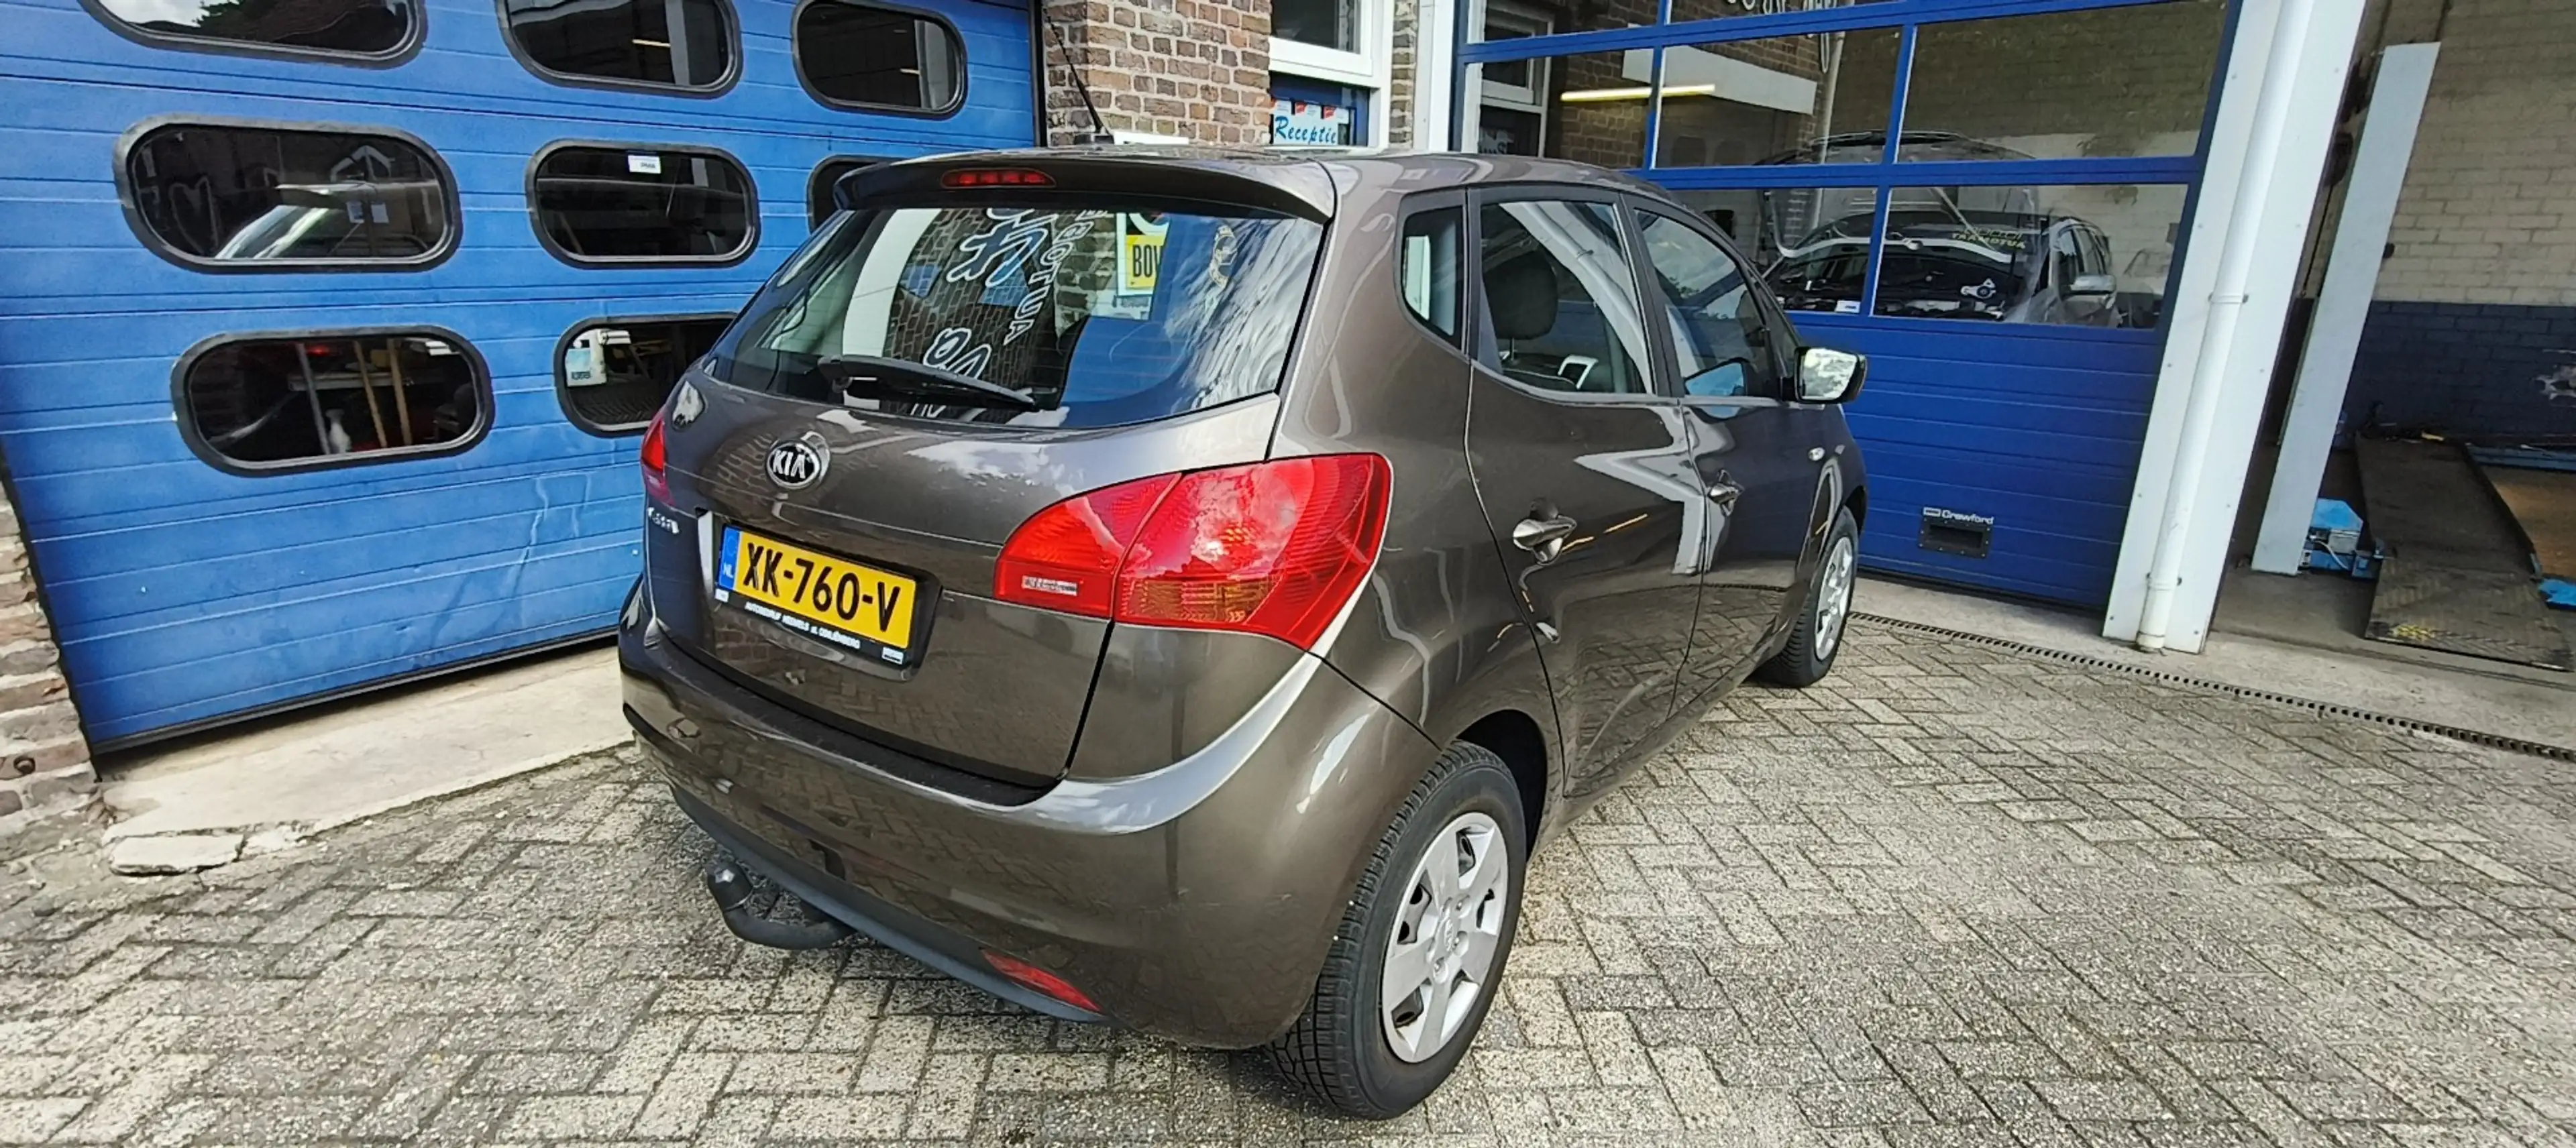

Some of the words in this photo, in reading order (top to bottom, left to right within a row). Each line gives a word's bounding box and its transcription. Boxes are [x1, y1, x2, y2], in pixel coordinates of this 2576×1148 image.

[1274, 115, 1337, 144] Receptie
[772, 449, 806, 479] KIA
[1941, 509, 1994, 525] Crawford
[722, 563, 734, 579] NL
[743, 542, 901, 633] XK-760-V
